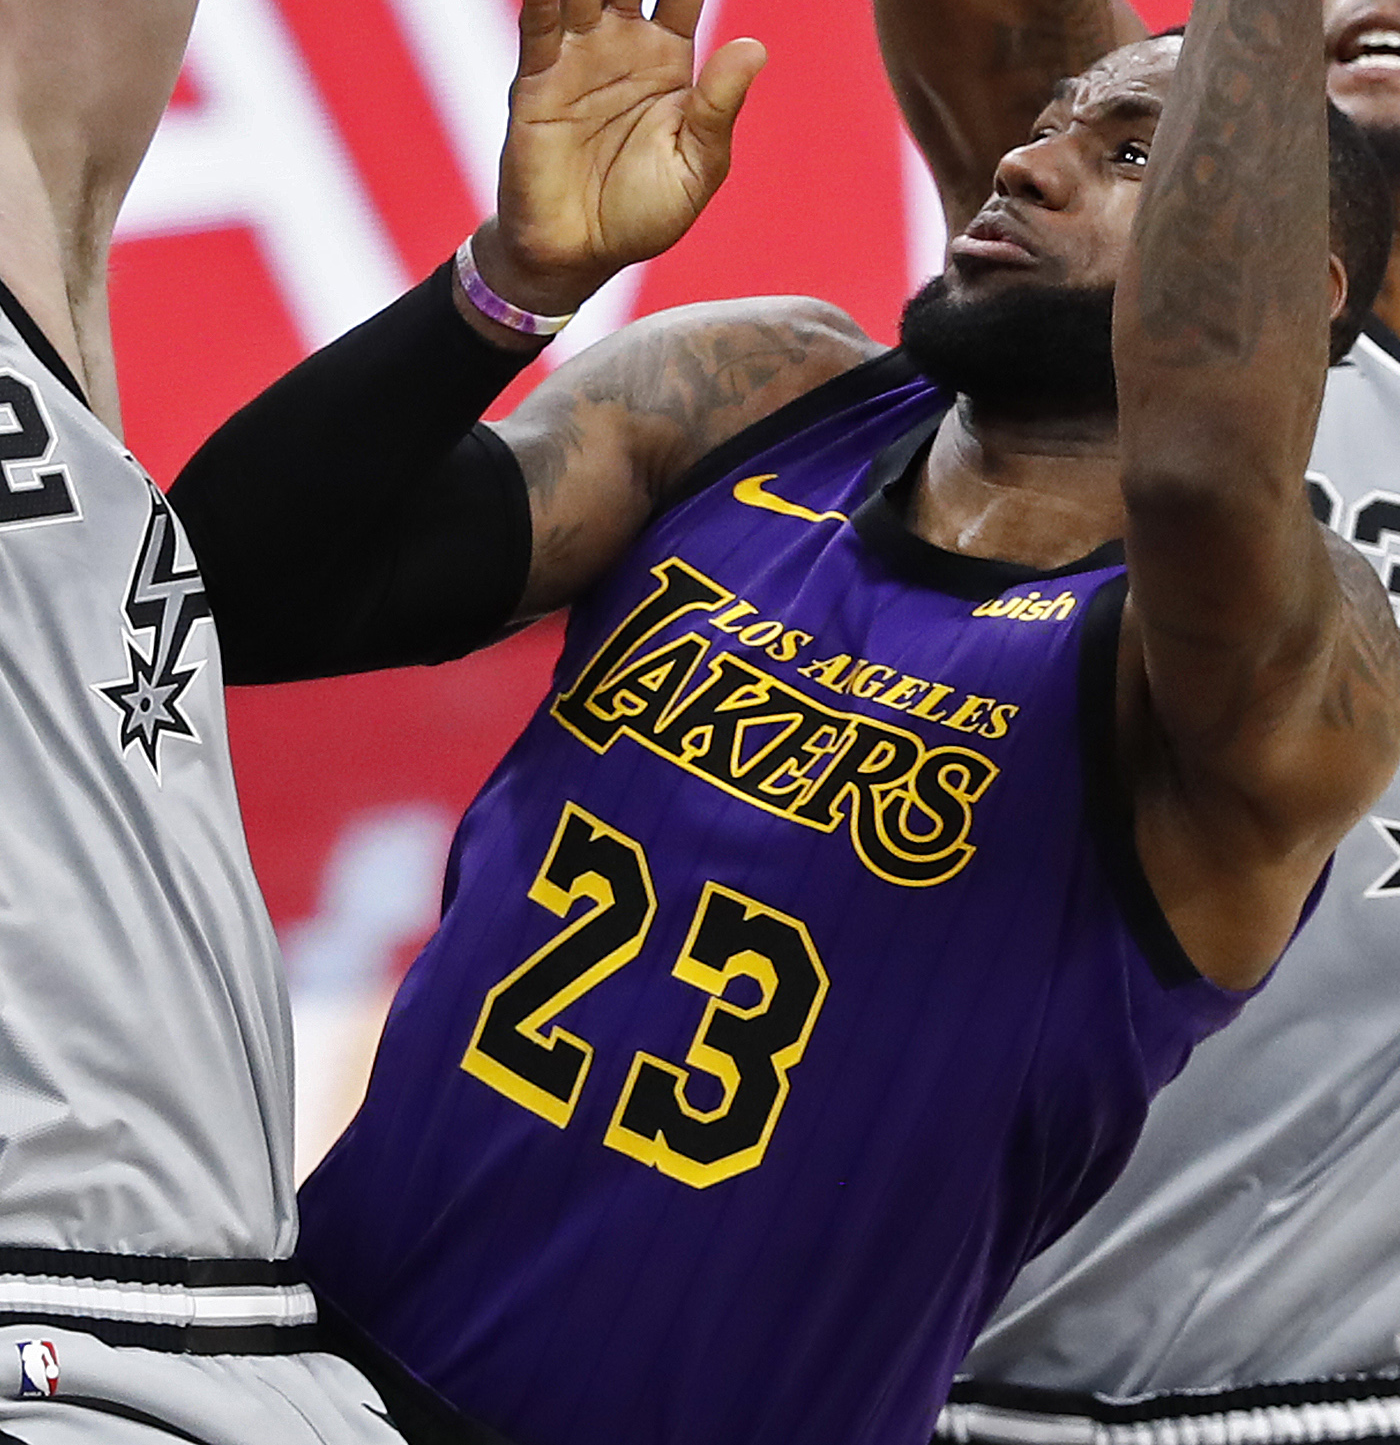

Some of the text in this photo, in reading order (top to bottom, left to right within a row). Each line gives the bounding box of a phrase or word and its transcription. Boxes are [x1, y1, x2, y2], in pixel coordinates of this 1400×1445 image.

[549, 556, 1000, 888] LAKERS
[708, 600, 1020, 740] LOS AGELES
[971, 590, 1078, 622] wish
[459, 800, 831, 1190] 23
